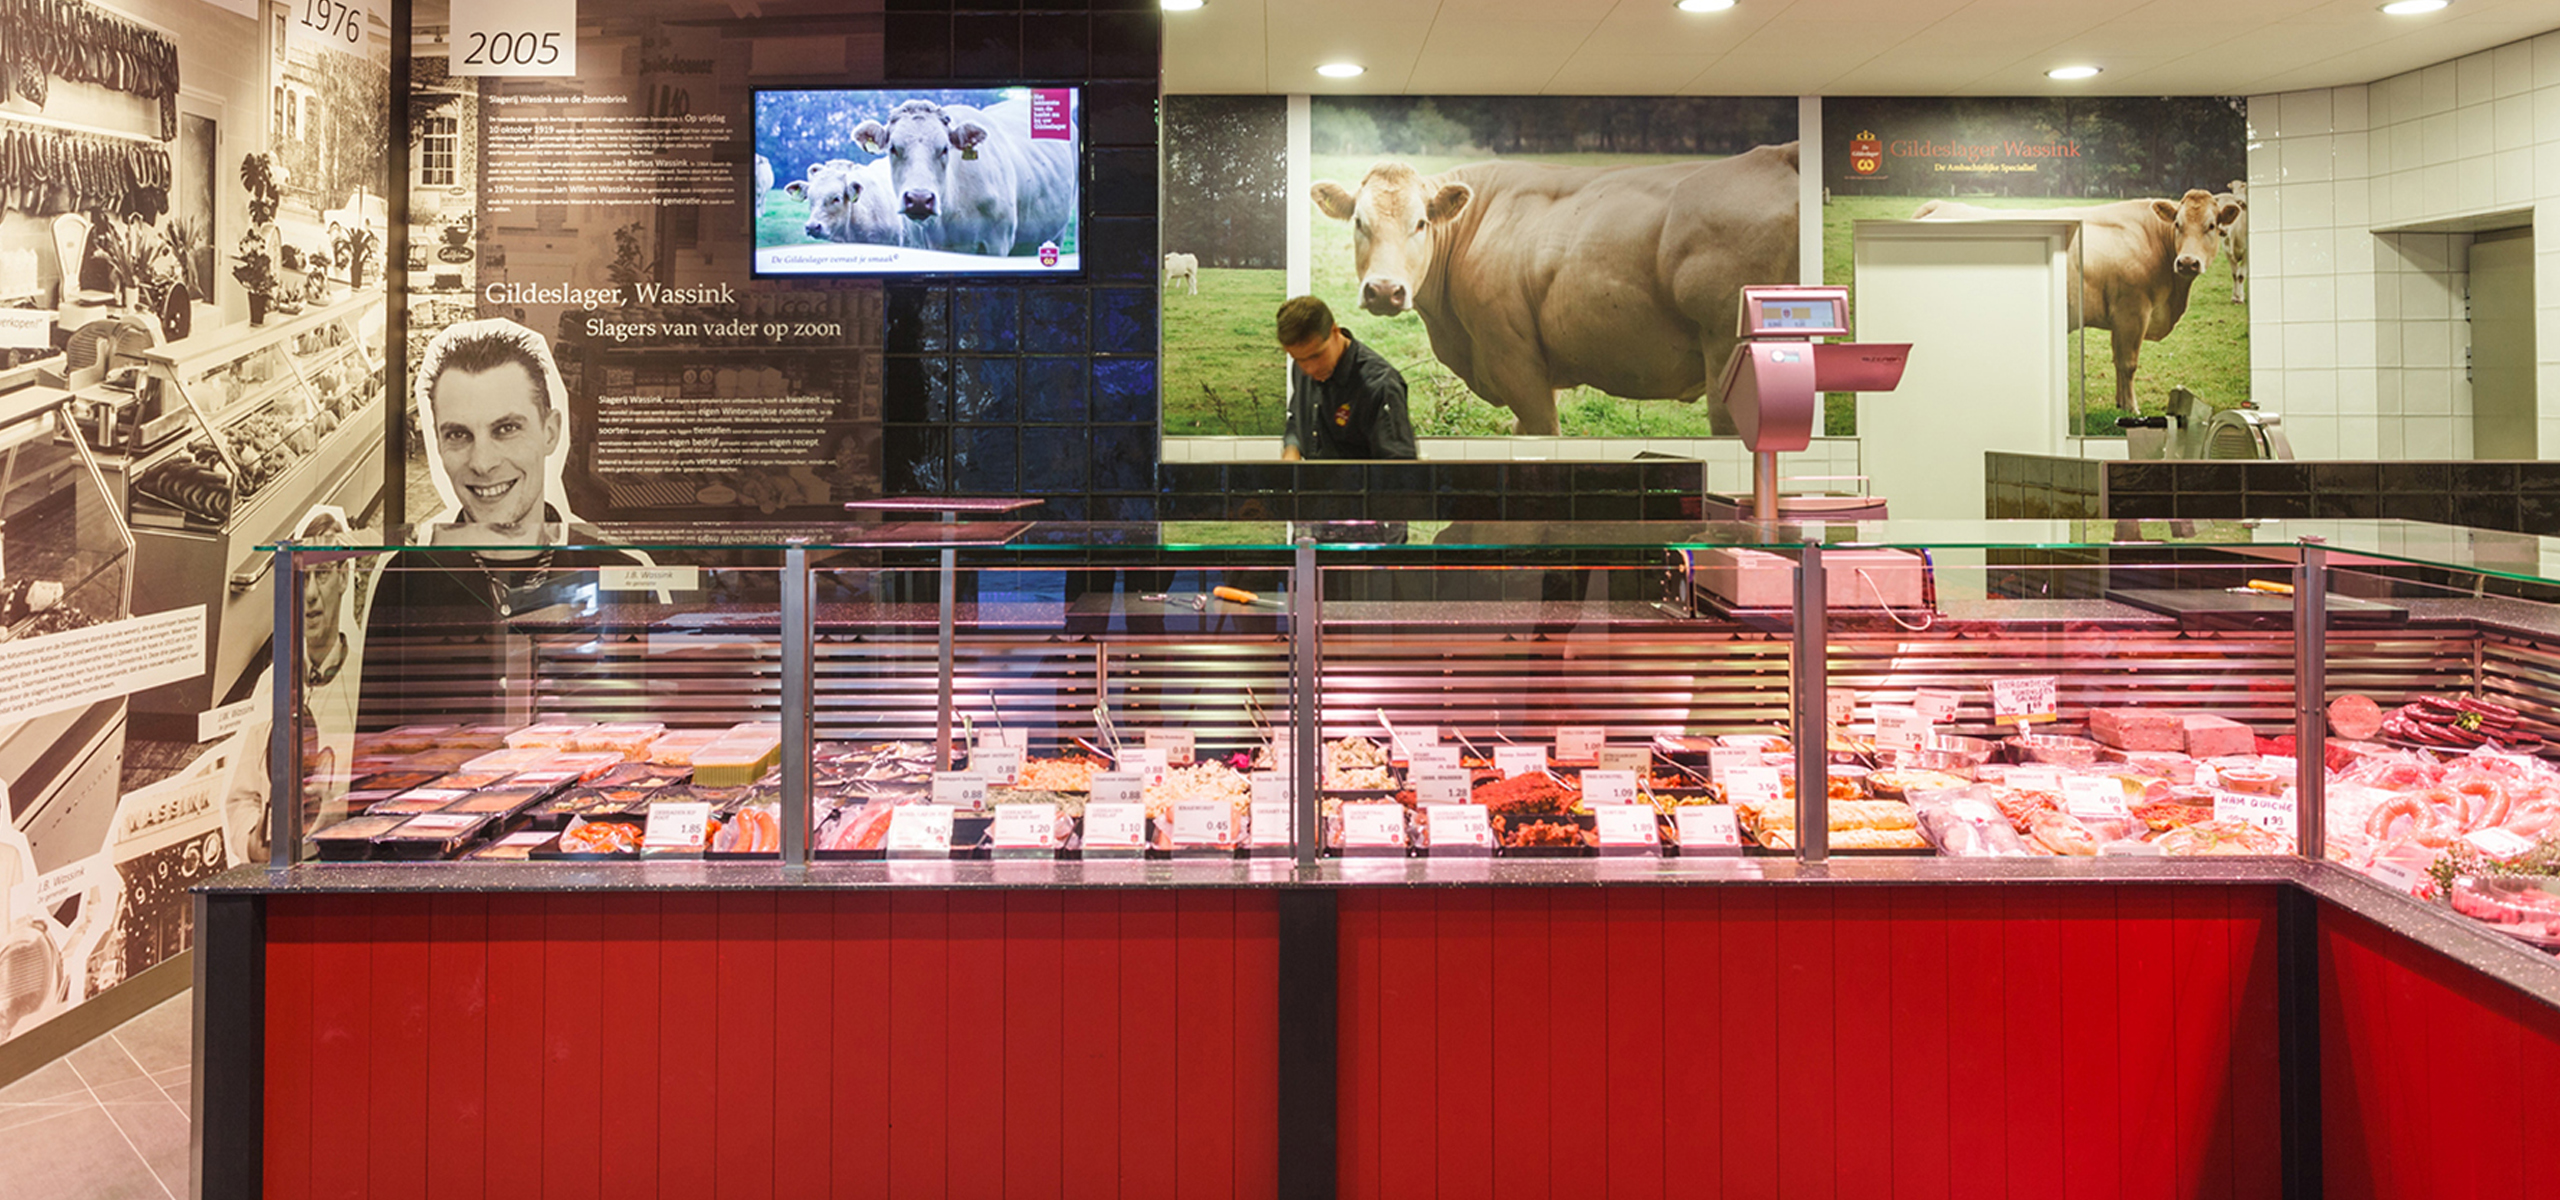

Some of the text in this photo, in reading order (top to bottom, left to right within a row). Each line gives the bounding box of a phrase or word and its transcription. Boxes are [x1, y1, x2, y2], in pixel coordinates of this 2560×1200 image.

[301, 0, 361, 43] 1976
[463, 31, 561, 65] 2005
[488, 94, 628, 105] Slagerij Wassink aan de Zonnebrink
[684, 113, 698, 124] Op
[698, 114, 726, 124] vrijdag
[488, 126, 500, 135] 10
[501, 126, 533, 135] oktober
[535, 125, 555, 134] 1919
[1889, 140, 2082, 163] Gildeslager Wassink
[612, 158, 688, 167] Jan Bertus Wassink
[1934, 163, 2038, 174] De Ambachtelijke Specialist!
[494, 185, 514, 193] 1976
[553, 184, 632, 194] Jan Willem Wassink
[651, 196, 662, 205] 4e
[662, 196, 701, 207] generatie
[784, 255, 828, 266] Gildeslager
[485, 282, 736, 311] Gildeslager, Wassink
[586, 318, 843, 342] Slagers van vader op zoon
[598, 395, 629, 406] Slagerij
[786, 395, 821, 404] kwaliteit
[697, 407, 721, 417] eigen
[721, 407, 778, 417] Winterswijkse
[598, 426, 630, 435] soorten
[693, 426, 732, 436] tientallen
[668, 437, 719, 448] eigen bedrijf
[769, 438, 792, 448] eigen
[696, 457, 742, 466] verse worst
[640, 570, 674, 580] Wassink
[1905, 733, 1923, 742] 1.75
[997, 765, 1016, 774] 0.88
[1144, 766, 1164, 774] 0.88
[1757, 783, 1778, 792] 3.50
[962, 790, 983, 799] 0.88
[1120, 790, 1141, 800] 0.88
[1448, 788, 1468, 798] 1.28
[1614, 788, 1633, 798] 1.09
[2221, 795, 2293, 813] HAM QUICHE
[127, 789, 210, 834] WASSINK
[681, 823, 702, 834] 1.85
[1029, 823, 1051, 833] 1.20
[1120, 823, 1141, 832] 1.10
[1206, 821, 1229, 830] 0.45
[1380, 823, 1400, 833] 1.60
[1463, 823, 1485, 833] 1.80
[1713, 824, 1734, 834] 1.35
[180, 831, 222, 878] 50
